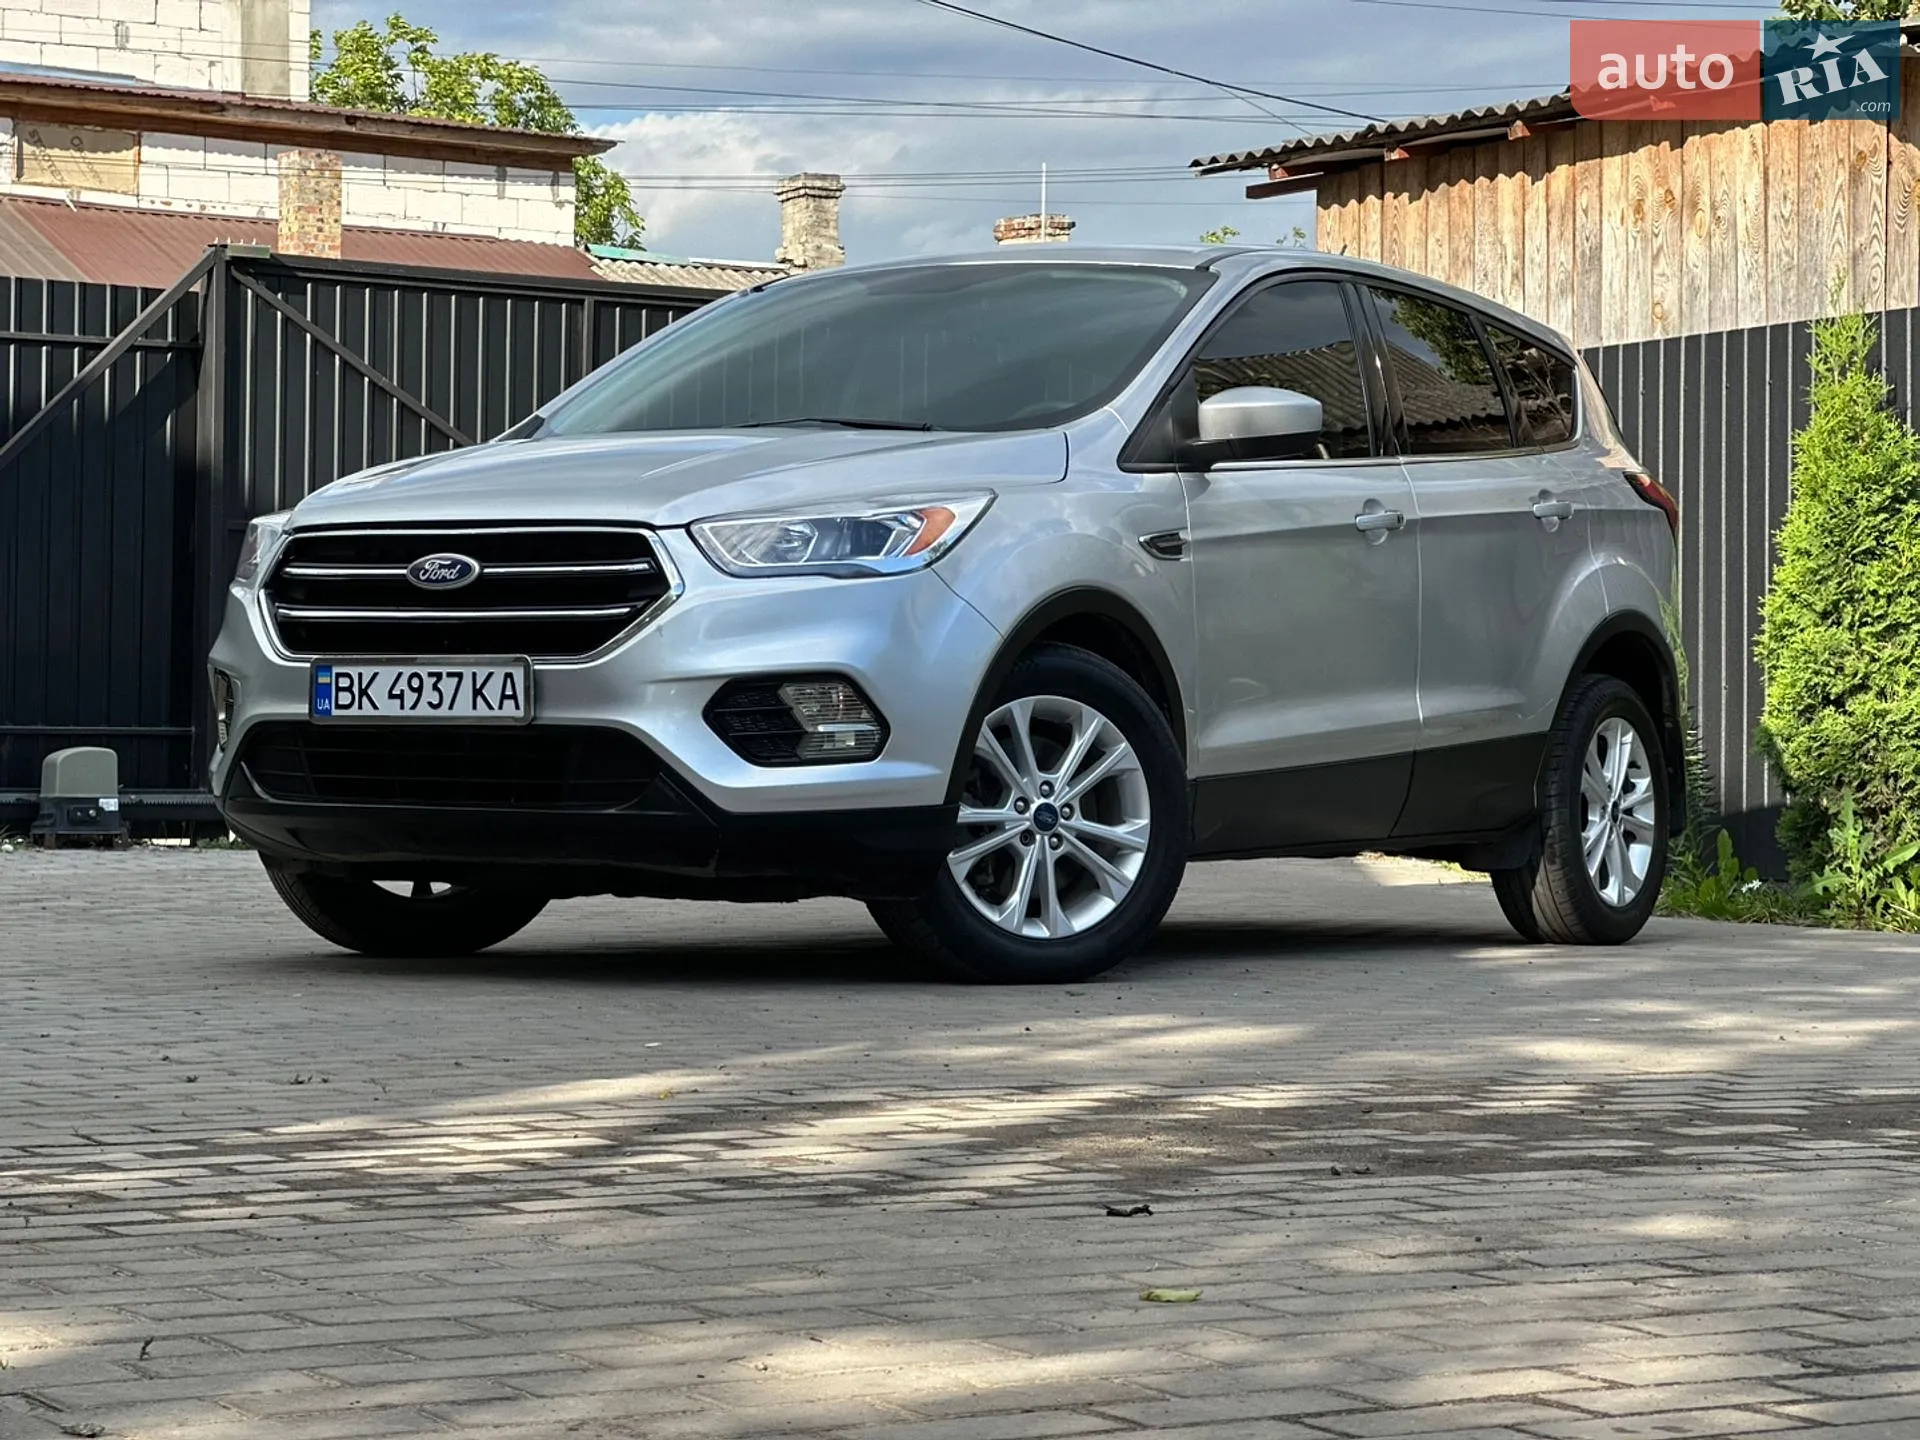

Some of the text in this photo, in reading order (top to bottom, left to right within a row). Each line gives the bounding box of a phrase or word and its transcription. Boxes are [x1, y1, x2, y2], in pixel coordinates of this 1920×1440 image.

[419, 559, 462, 580] Ford
[334, 671, 520, 710] BK 4937 KA
[317, 699, 330, 709] UA
